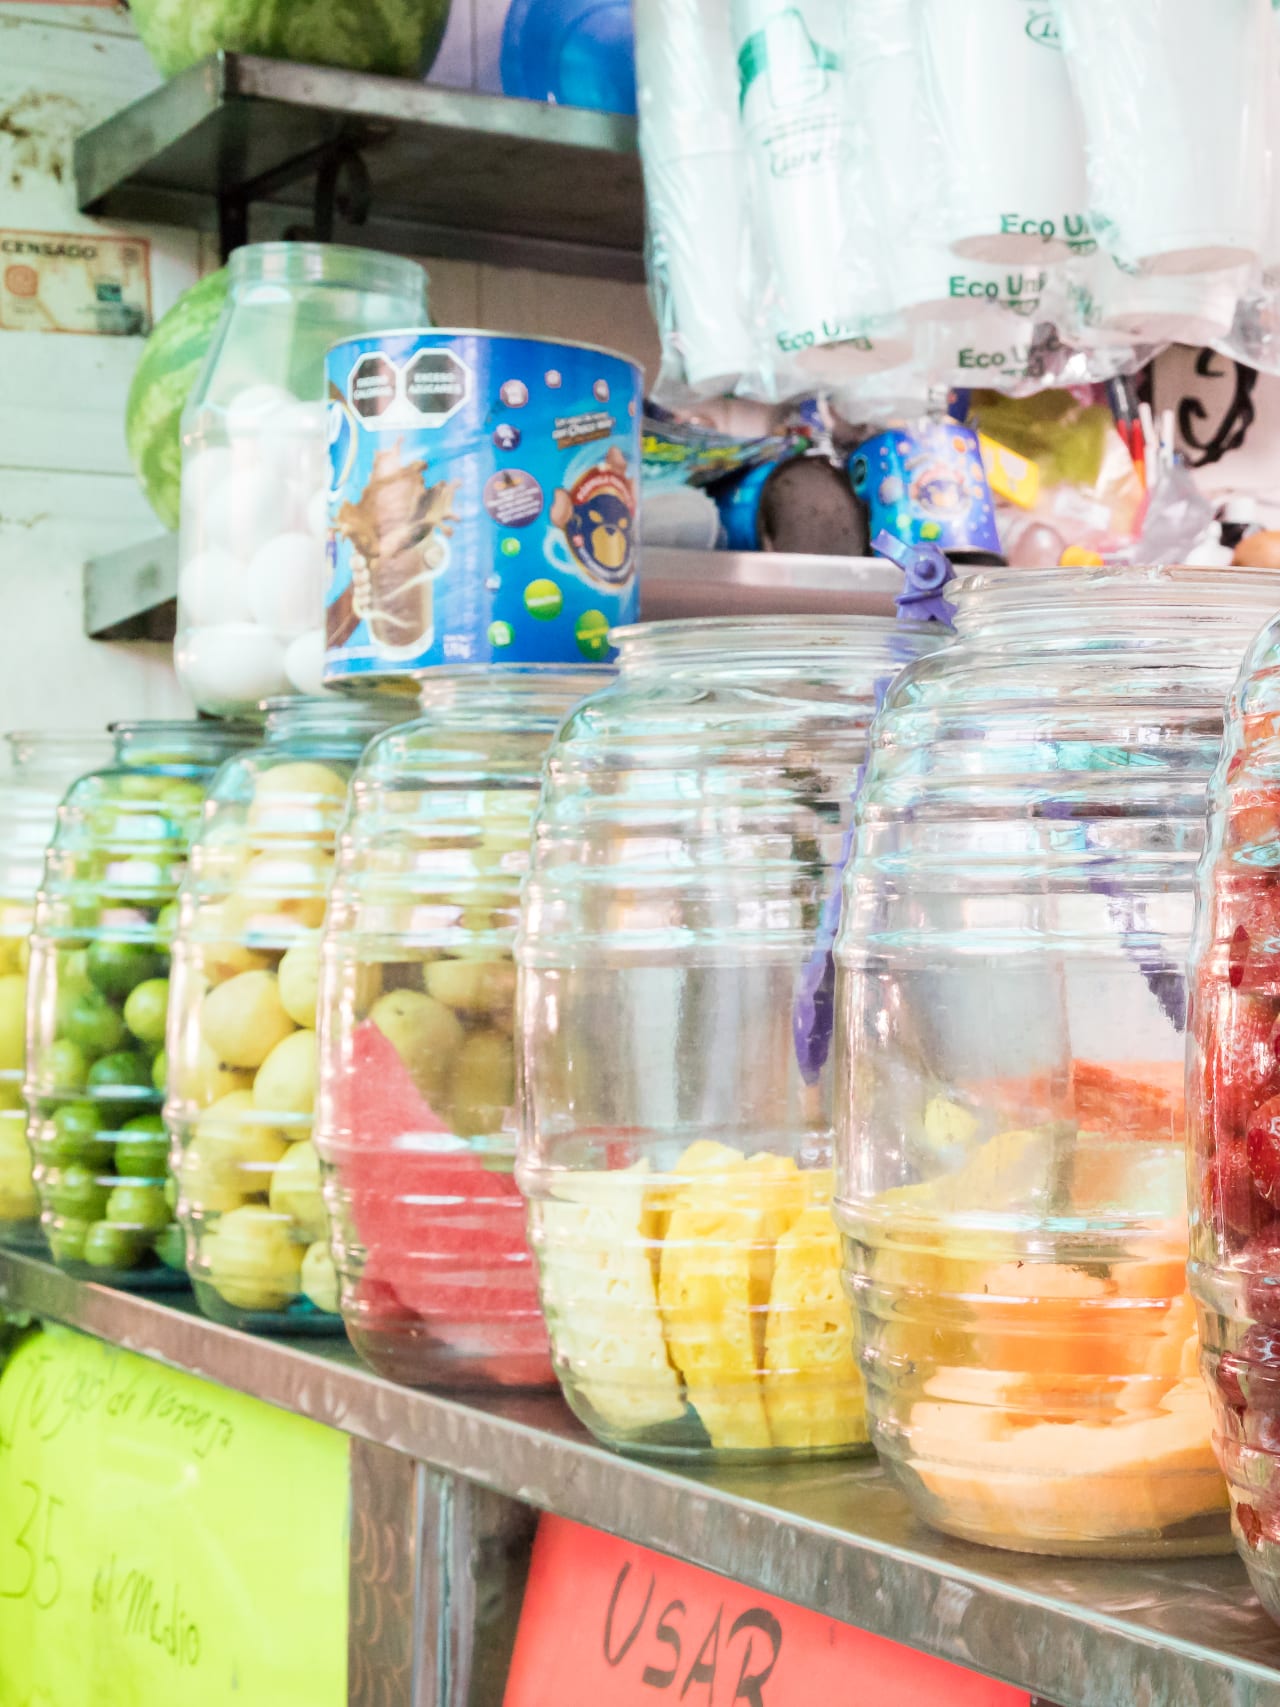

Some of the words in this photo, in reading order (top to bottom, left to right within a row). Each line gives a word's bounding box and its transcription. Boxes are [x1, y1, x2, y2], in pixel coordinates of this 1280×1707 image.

[1000, 213, 1056, 238] Eco
[949, 275, 999, 299] Eco
[957, 347, 1006, 370] Eco
[603, 1560, 782, 1707] USAR
